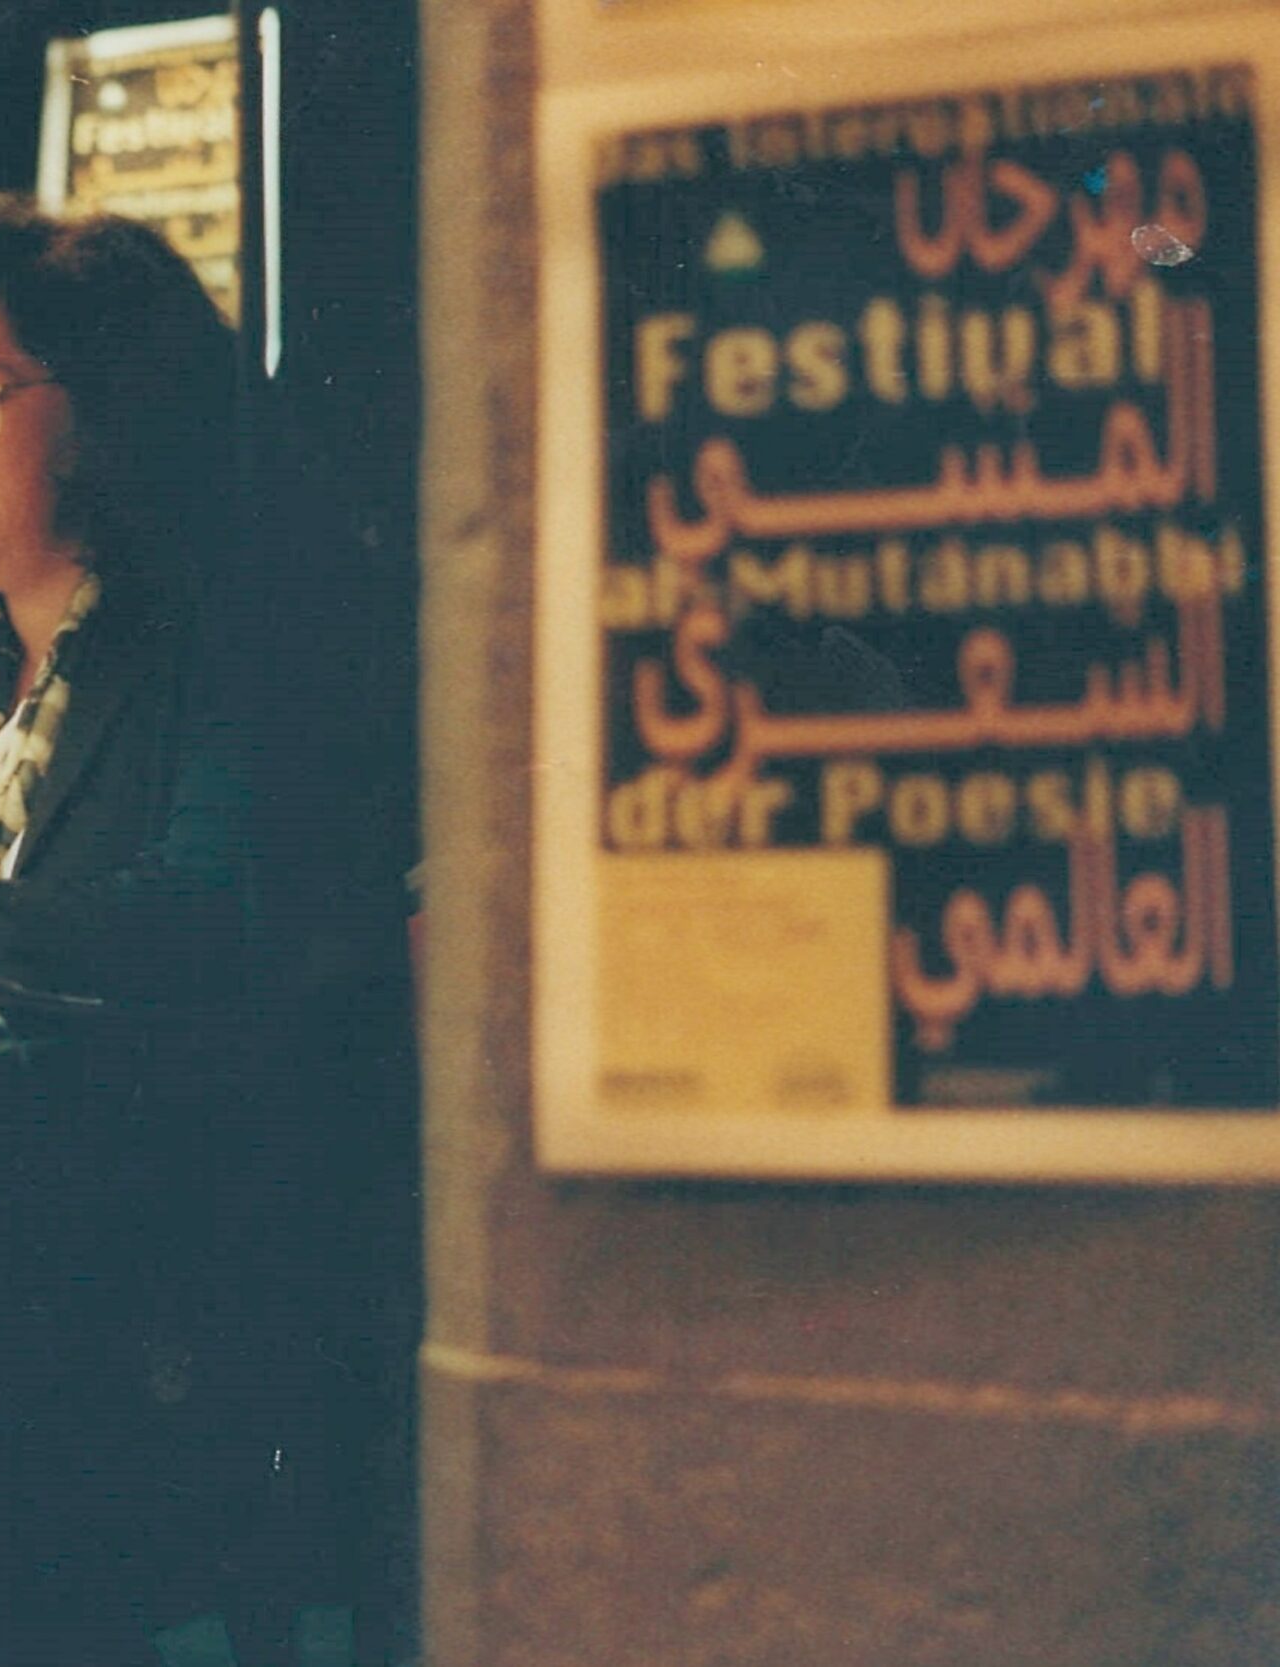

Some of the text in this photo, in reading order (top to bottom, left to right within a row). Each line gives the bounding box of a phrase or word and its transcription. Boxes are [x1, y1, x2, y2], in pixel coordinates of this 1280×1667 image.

[632, 278, 1164, 424] Festival
[608, 753, 1185, 850] der Poesie
